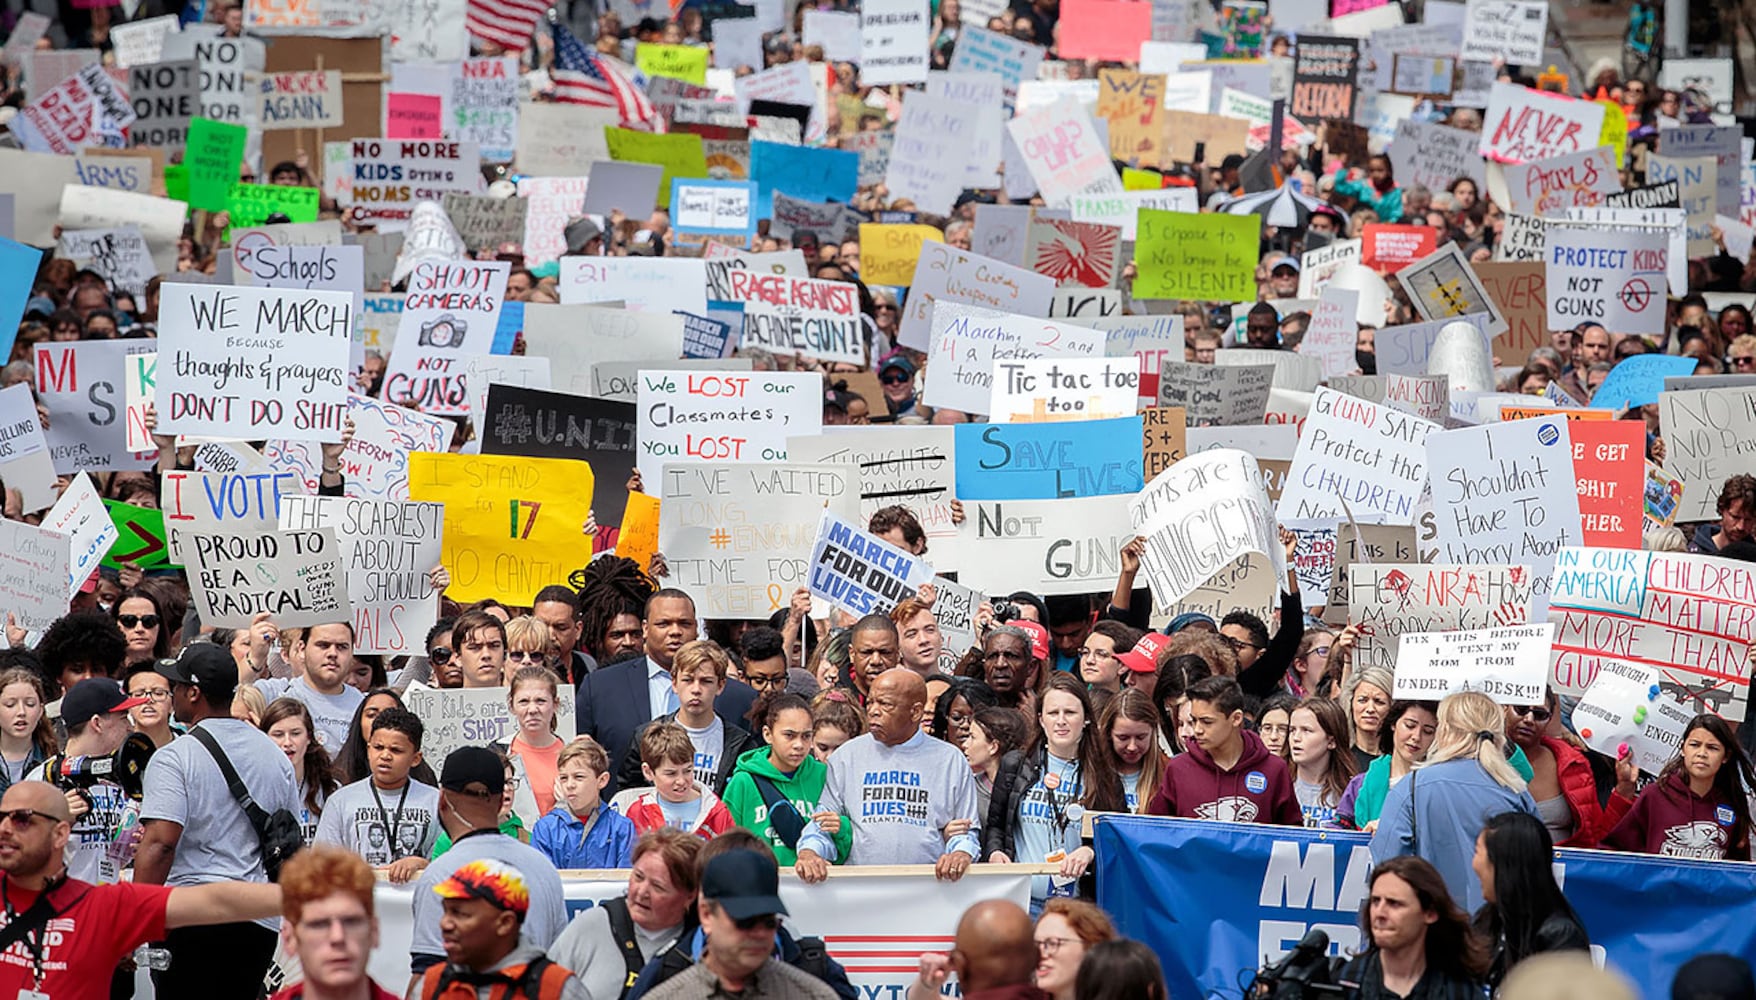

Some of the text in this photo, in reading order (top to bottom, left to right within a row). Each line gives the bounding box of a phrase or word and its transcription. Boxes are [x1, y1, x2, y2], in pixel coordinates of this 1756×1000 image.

[132, 66, 191, 91] NOT
[462, 60, 506, 80] NRA
[134, 96, 194, 119] ONE
[262, 96, 330, 122] AGAIN.
[1292, 82, 1352, 119] REFORM
[1490, 104, 1583, 152] NEVER
[353, 142, 460, 159] NO MORE
[354, 164, 454, 182] KIDS DYING
[352, 187, 410, 202] MOMS
[1144, 220, 1236, 243] I choose to
[254, 246, 337, 281] Schools
[1151, 249, 1242, 268] No longer be
[1305, 243, 1356, 269] Listen
[1553, 245, 1667, 271] PROTECT KIDS
[415, 262, 500, 293] SHOOT
[975, 264, 1021, 299] Century
[1160, 270, 1249, 293] SILENT!
[1567, 277, 1604, 292] NOT
[406, 292, 494, 313] CAMERAS
[731, 270, 855, 316] RAGE AGAINST
[1554, 297, 1606, 318] GUNS
[190, 290, 350, 338] WE MARCH
[226, 336, 285, 350] BECAUSE
[804, 319, 859, 355] GUN!
[942, 337, 1044, 362] 4 a better
[944, 318, 1095, 354] Marching 2 and
[37, 347, 78, 394] M
[172, 350, 254, 391] thoughts
[276, 361, 343, 395] prayers
[416, 356, 457, 373] NOT
[1000, 363, 1139, 395] Tic tac toe
[383, 371, 468, 407] GUNS
[645, 374, 796, 398] We LOST our
[1386, 374, 1448, 404] WALKING
[87, 380, 116, 427] S
[170, 391, 349, 432] DON'T DO SHIT
[649, 402, 790, 427] Classmates,
[1047, 396, 1085, 412] too
[1316, 390, 1377, 429] G(UN)
[1669, 388, 1732, 431] NO
[50, 442, 91, 461] NEVER
[642, 434, 747, 461] You LOST
[978, 425, 1075, 469] SAVE
[1309, 428, 1383, 468] Protect
[1390, 452, 1423, 482] the
[1486, 429, 1494, 460] I
[1595, 443, 1630, 462] GET
[1670, 428, 1712, 459] NO
[72, 454, 112, 469] AGAIN
[419, 456, 541, 489] I STAND
[1671, 458, 1722, 483] WE
[666, 468, 845, 499] I'VE WAITED
[1055, 458, 1143, 499] LIVES
[1302, 462, 1413, 517] CHILDREN
[1447, 455, 1549, 504] Shouldn't
[1576, 477, 1618, 499] SHIT
[167, 473, 294, 521] I VOTE
[1131, 463, 1229, 530] arms are
[1296, 498, 1339, 519] Not
[342, 499, 445, 541] SCARIEST
[475, 497, 542, 541] for 17
[677, 502, 747, 528] LONG
[977, 503, 1042, 537] NOT
[1453, 497, 1546, 538] Have To
[77, 522, 115, 569] GUNS
[194, 531, 325, 569] PROUD TO
[351, 539, 422, 572] ABOUT
[828, 520, 913, 582] MARCH
[1394, 541, 1410, 558] Is
[1447, 531, 1570, 566] Worry About
[668, 558, 810, 587] TIME FOR
[819, 545, 918, 604] FOR OUR
[1558, 549, 1637, 574] IN OUR
[200, 568, 252, 590] BE A
[307, 579, 336, 592] GUNS
[364, 571, 433, 603] SHOULD
[811, 566, 877, 615] LIVES
[1350, 568, 1532, 613] Hey NRA How
[1554, 570, 1643, 609] AMERICA
[1648, 556, 1756, 604] CHILDREN
[205, 587, 313, 618] RADICAL
[933, 604, 971, 630] teach
[1648, 592, 1755, 642] MATTER
[1360, 606, 1433, 637] Many
[1442, 633, 1478, 643] THIS
[1490, 627, 1545, 639] BEFORE
[1435, 642, 1521, 655] I TEXT MY
[1558, 610, 1750, 677] MORE THAN
[1429, 656, 1515, 668] MOM FROM
[1603, 661, 1651, 686] ENOUGH!
[1397, 678, 1540, 700] UNDER A DESK!!!
[441, 691, 477, 720] Kids
[461, 717, 511, 741] SHOT
[863, 770, 921, 787] MARCH
[862, 786, 930, 804] FOR OUR
[862, 801, 906, 817] LIVES
[861, 816, 904, 824] ATLANTA
